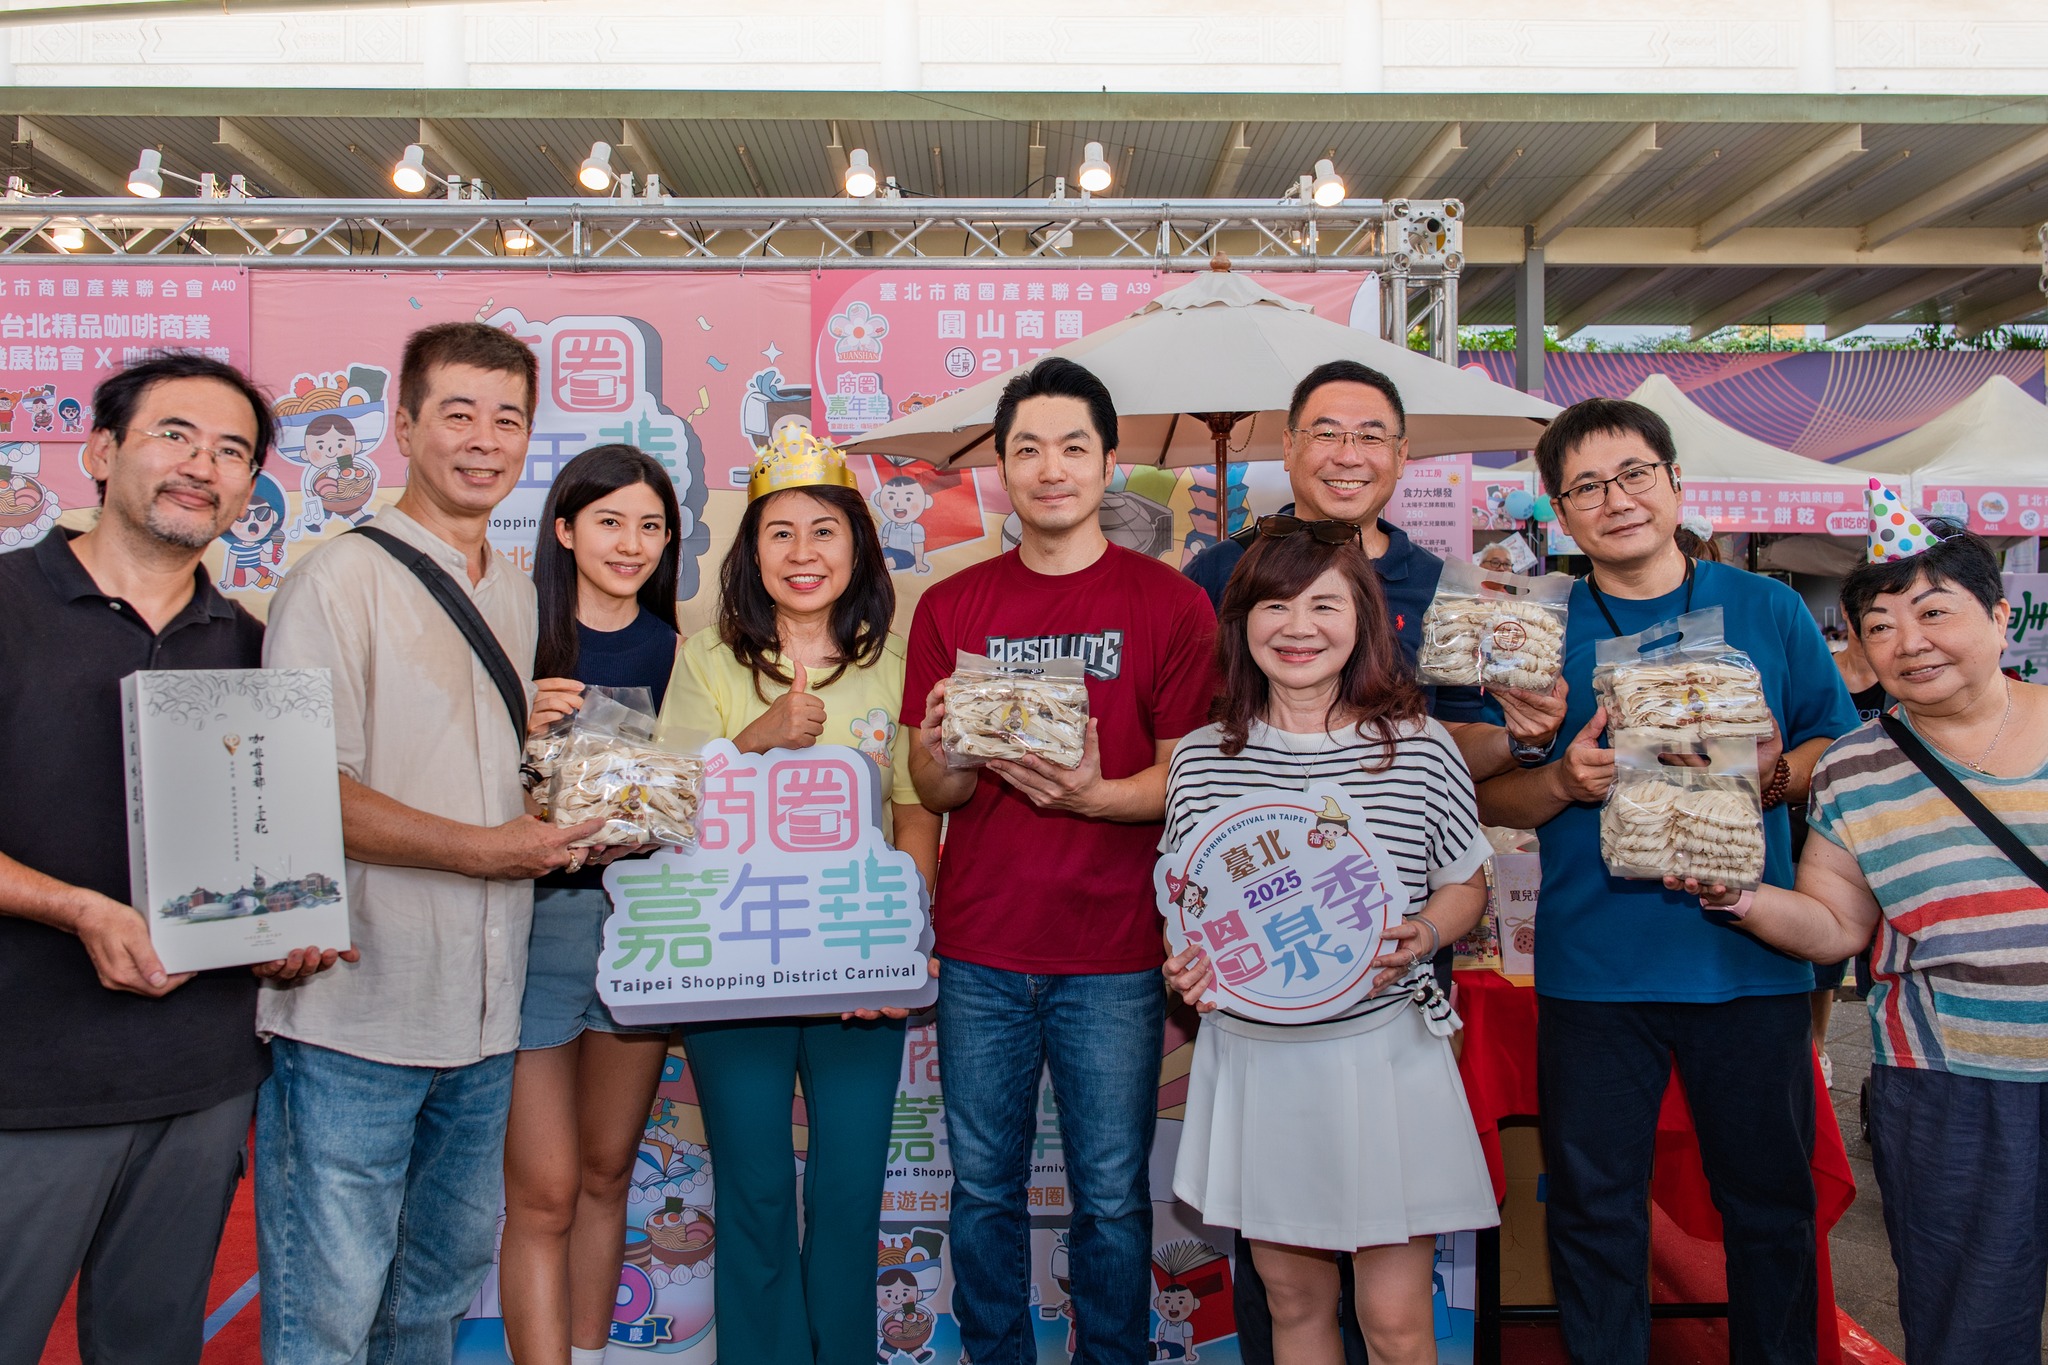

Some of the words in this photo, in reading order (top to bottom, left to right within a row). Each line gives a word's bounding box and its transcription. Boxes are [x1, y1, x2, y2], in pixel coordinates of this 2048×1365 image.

[211, 279, 237, 292] A40
[879, 282, 1119, 301] 臺北市商圈產業聯合會
[1126, 282, 1151, 295] A39
[0, 312, 211, 340] 台北精品咖啡商業
[938, 309, 1083, 339] 圓山商圈
[95, 347, 114, 369] X
[1194, 859, 1206, 876] HOT
[1202, 831, 1227, 858] SPRING
[1227, 814, 1265, 835] FESTIVAL
[1266, 813, 1276, 821] IN
[1279, 813, 1308, 824] TAIPEI
[1220, 829, 1291, 883] 臺北
[1243, 869, 1302, 910] 2025
[610, 977, 673, 994] Taipei
[681, 973, 766, 990] Shopping
[773, 968, 838, 985] District
[844, 964, 916, 981] Carnival
